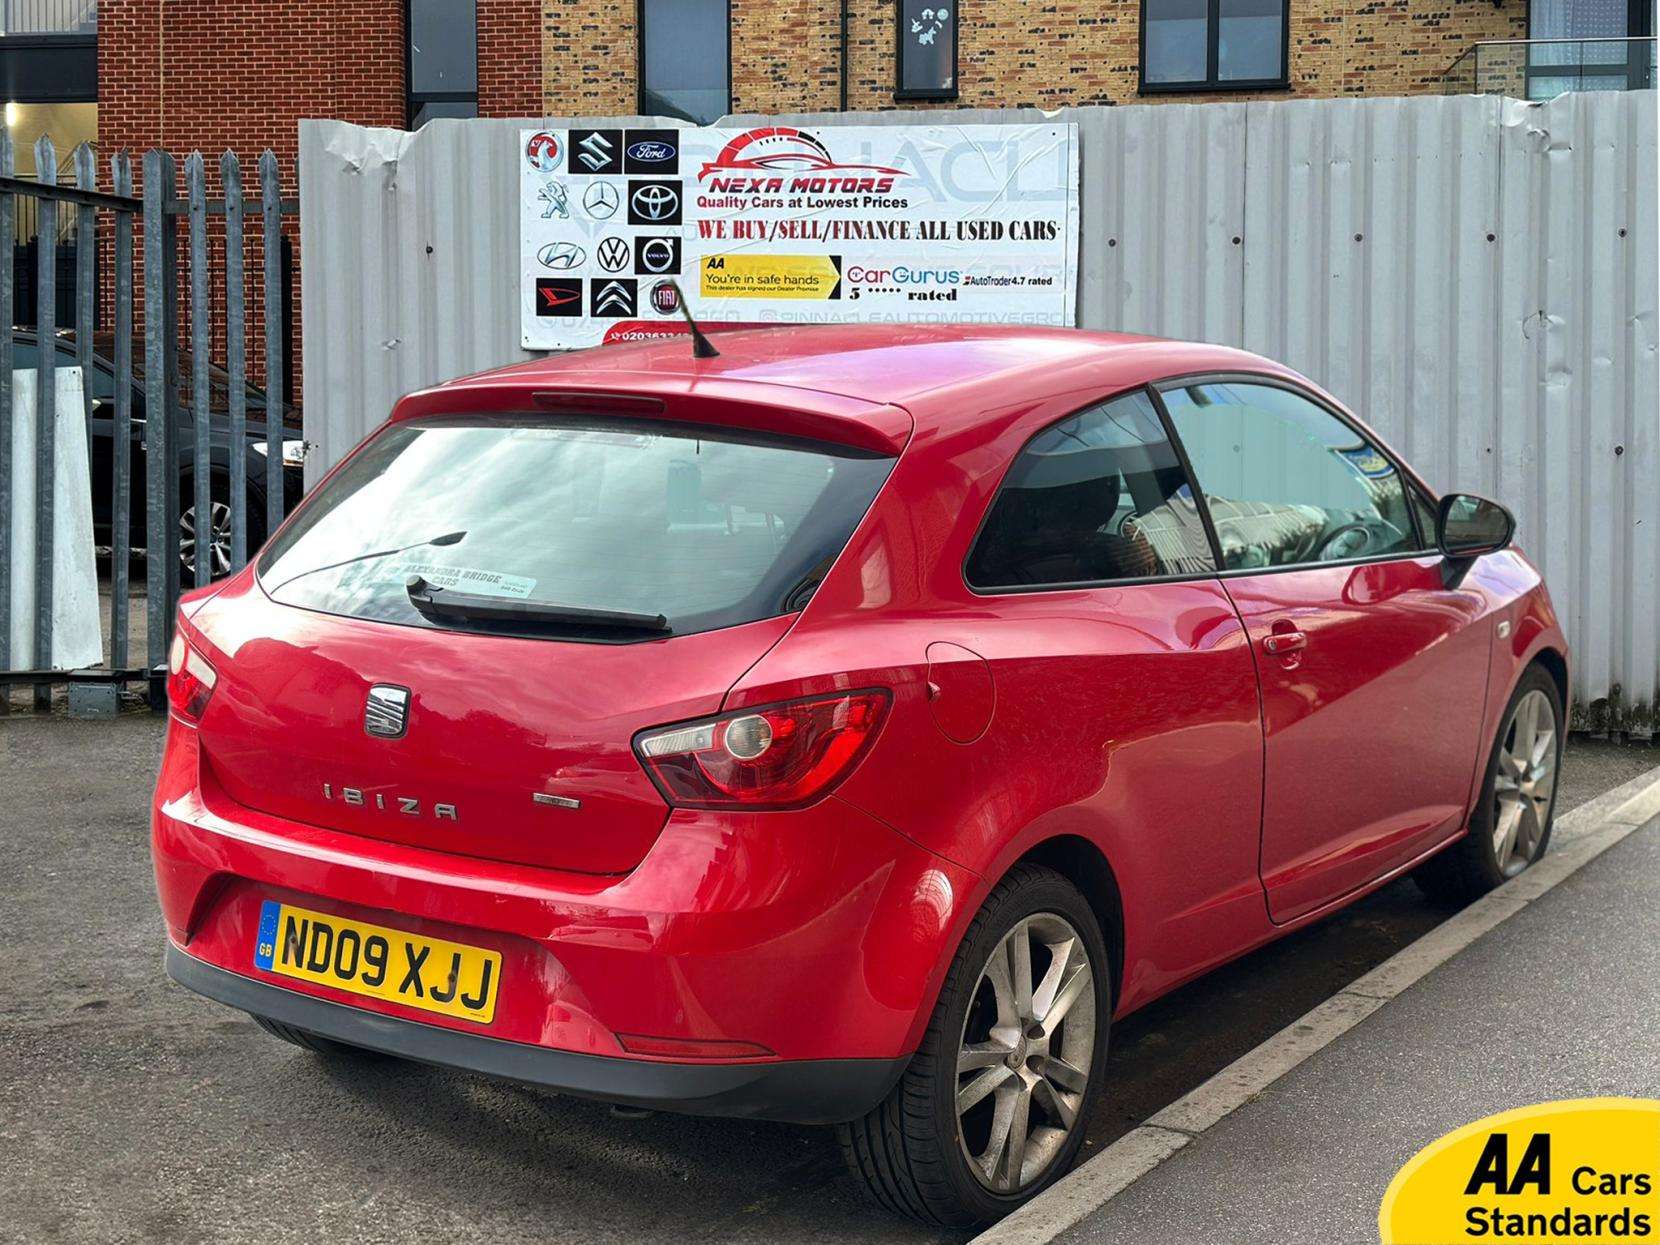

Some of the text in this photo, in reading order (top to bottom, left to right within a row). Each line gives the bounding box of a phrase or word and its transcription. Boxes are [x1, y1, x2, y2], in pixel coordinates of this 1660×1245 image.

[636, 144, 666, 159] Ford
[708, 178, 894, 194] NEXA MOTORS
[697, 195, 908, 210] Quality Cars at Lowest Prices
[697, 219, 727, 239] WE
[916, 220, 951, 240] ALL
[956, 220, 1003, 241] USED
[706, 257, 725, 269] AA
[705, 273, 819, 285] You're in safe hands
[847, 266, 960, 284] CarGurus
[1028, 277, 1053, 286] rated
[849, 288, 957, 301] 5 rated
[323, 783, 458, 821] IBIZA
[259, 943, 273, 957] GB
[281, 915, 493, 1011] ND09 XJJ
